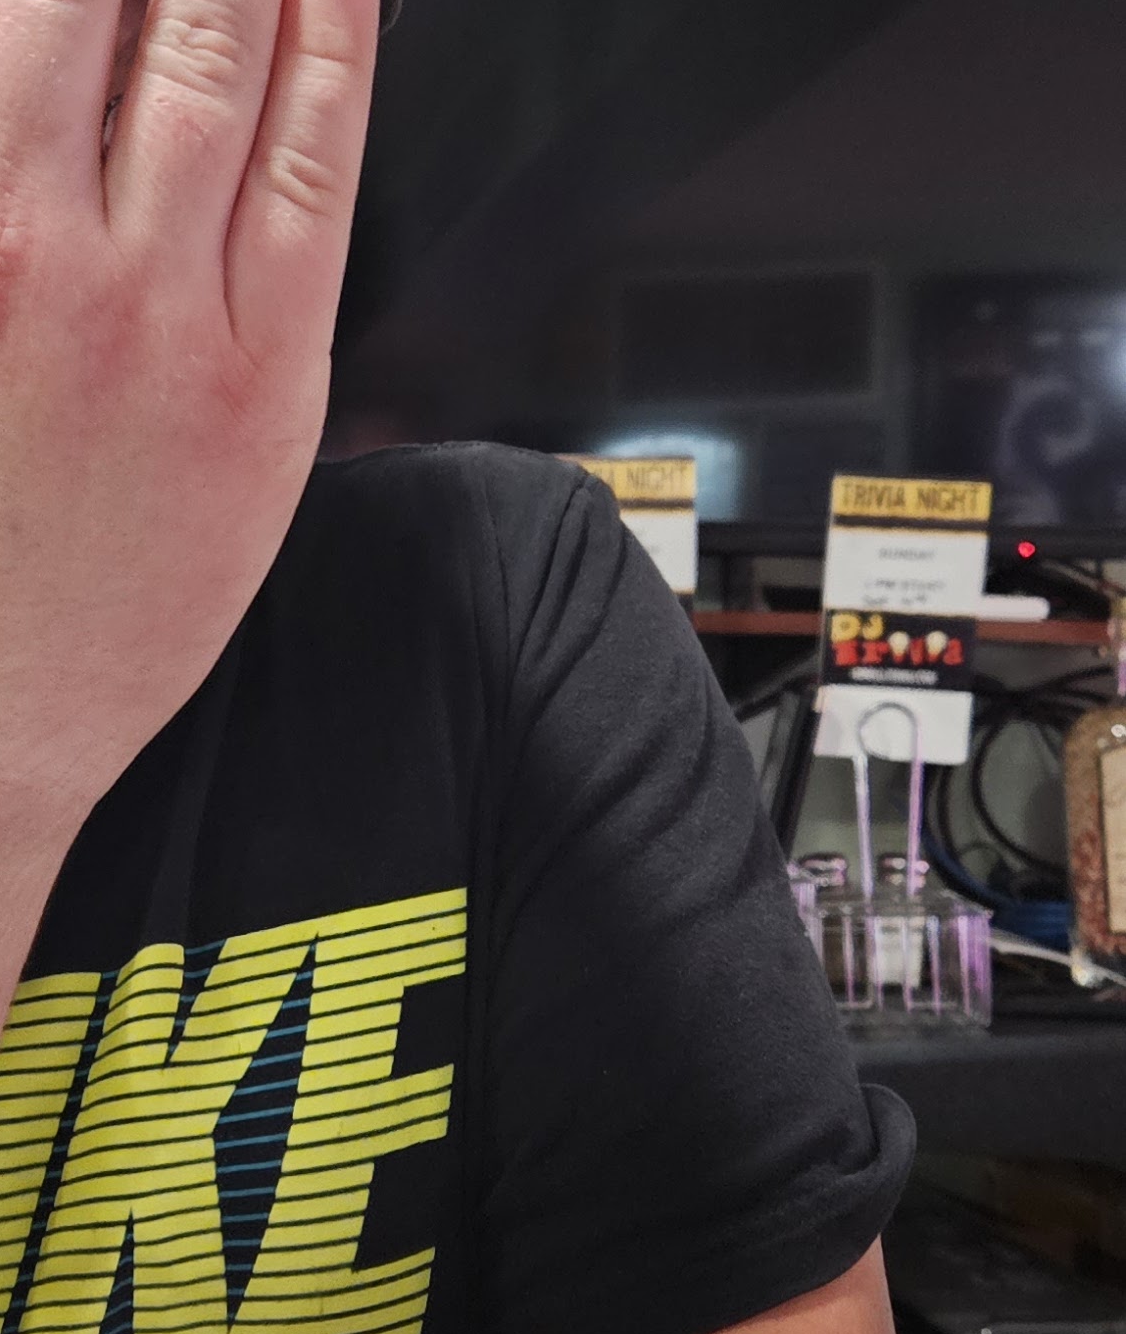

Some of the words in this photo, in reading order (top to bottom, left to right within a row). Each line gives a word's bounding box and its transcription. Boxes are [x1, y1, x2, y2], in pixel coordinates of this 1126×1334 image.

[626, 465, 690, 490] NIGHT
[841, 483, 905, 508] TRIVIA
[917, 486, 980, 511] NIGHT
